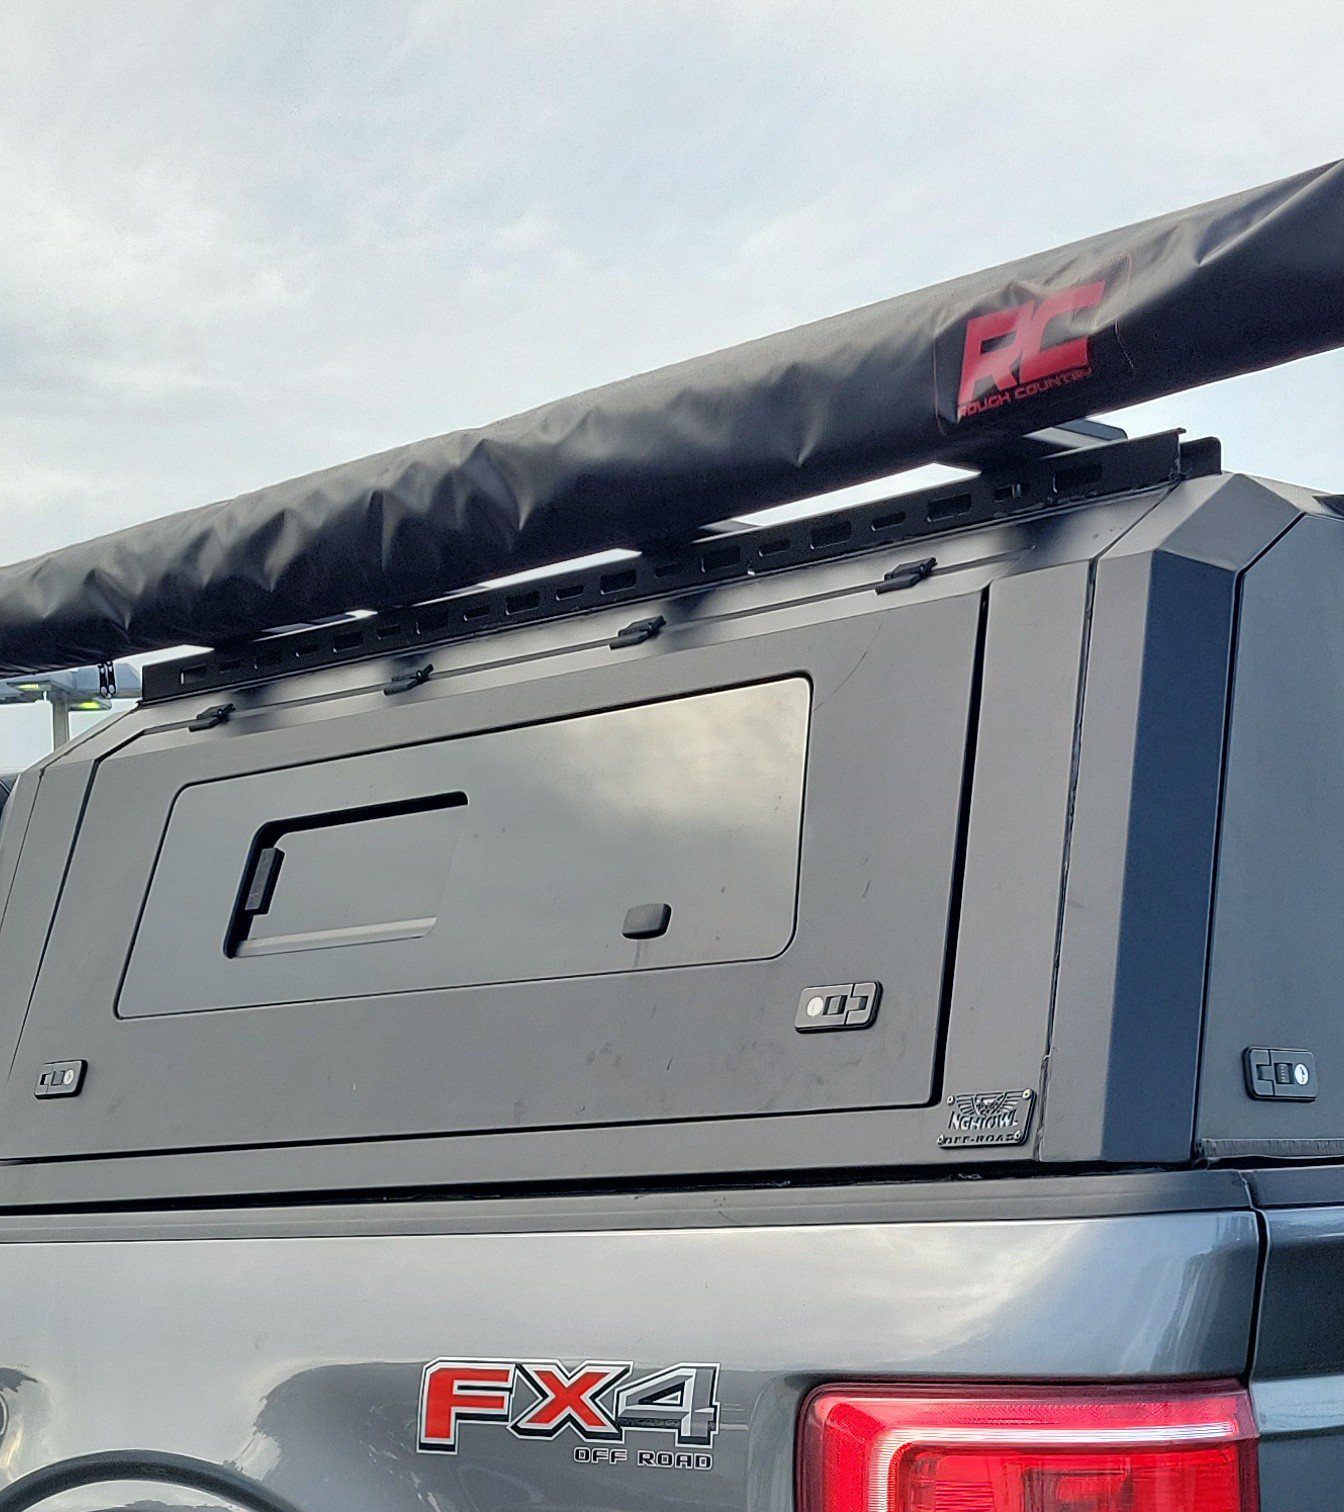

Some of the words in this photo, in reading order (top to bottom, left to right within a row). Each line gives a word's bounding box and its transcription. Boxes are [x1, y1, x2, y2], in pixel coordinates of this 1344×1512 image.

[958, 279, 1106, 404] RC
[416, 1356, 722, 1456] FX4
[572, 1447, 628, 1464] OFF
[637, 1450, 715, 1471] ROAD
